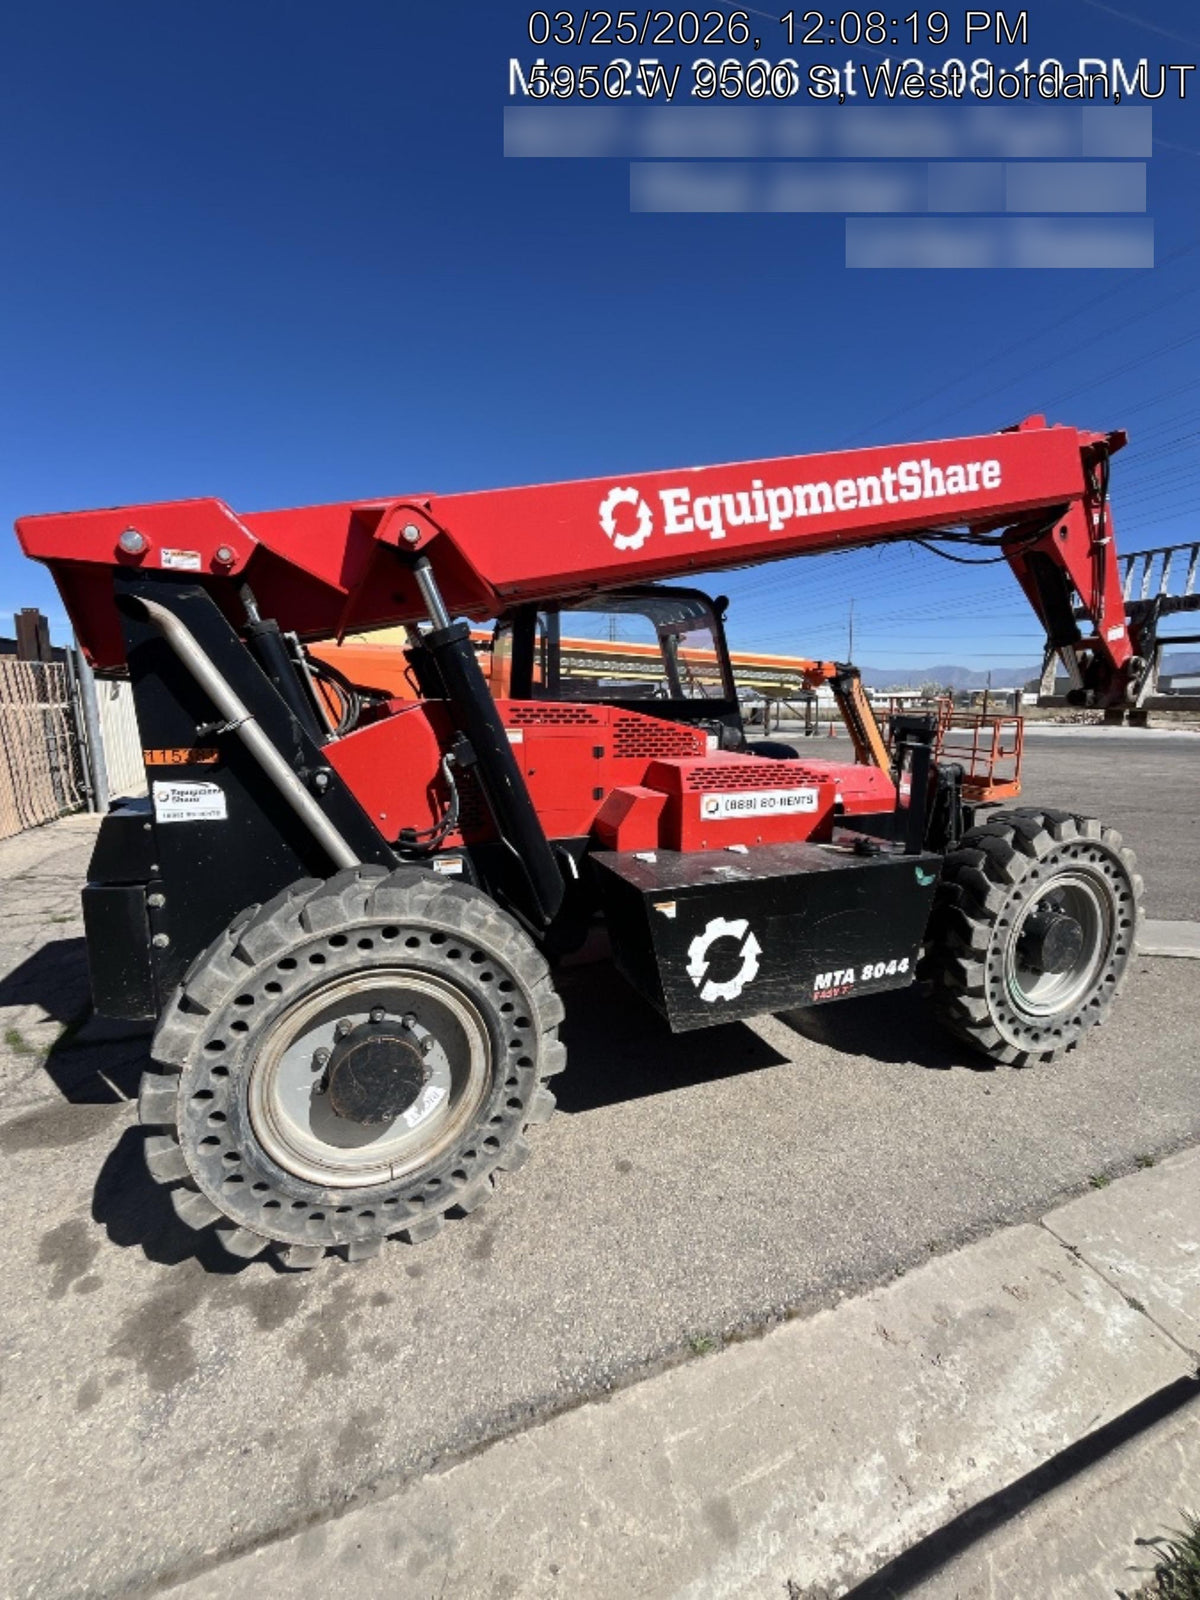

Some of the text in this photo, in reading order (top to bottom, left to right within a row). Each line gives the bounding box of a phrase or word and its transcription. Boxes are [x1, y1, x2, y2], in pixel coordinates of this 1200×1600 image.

[658, 457, 1002, 540] EquipmentShare
[814, 968, 855, 991] MTA
[861, 957, 909, 980] 8044
